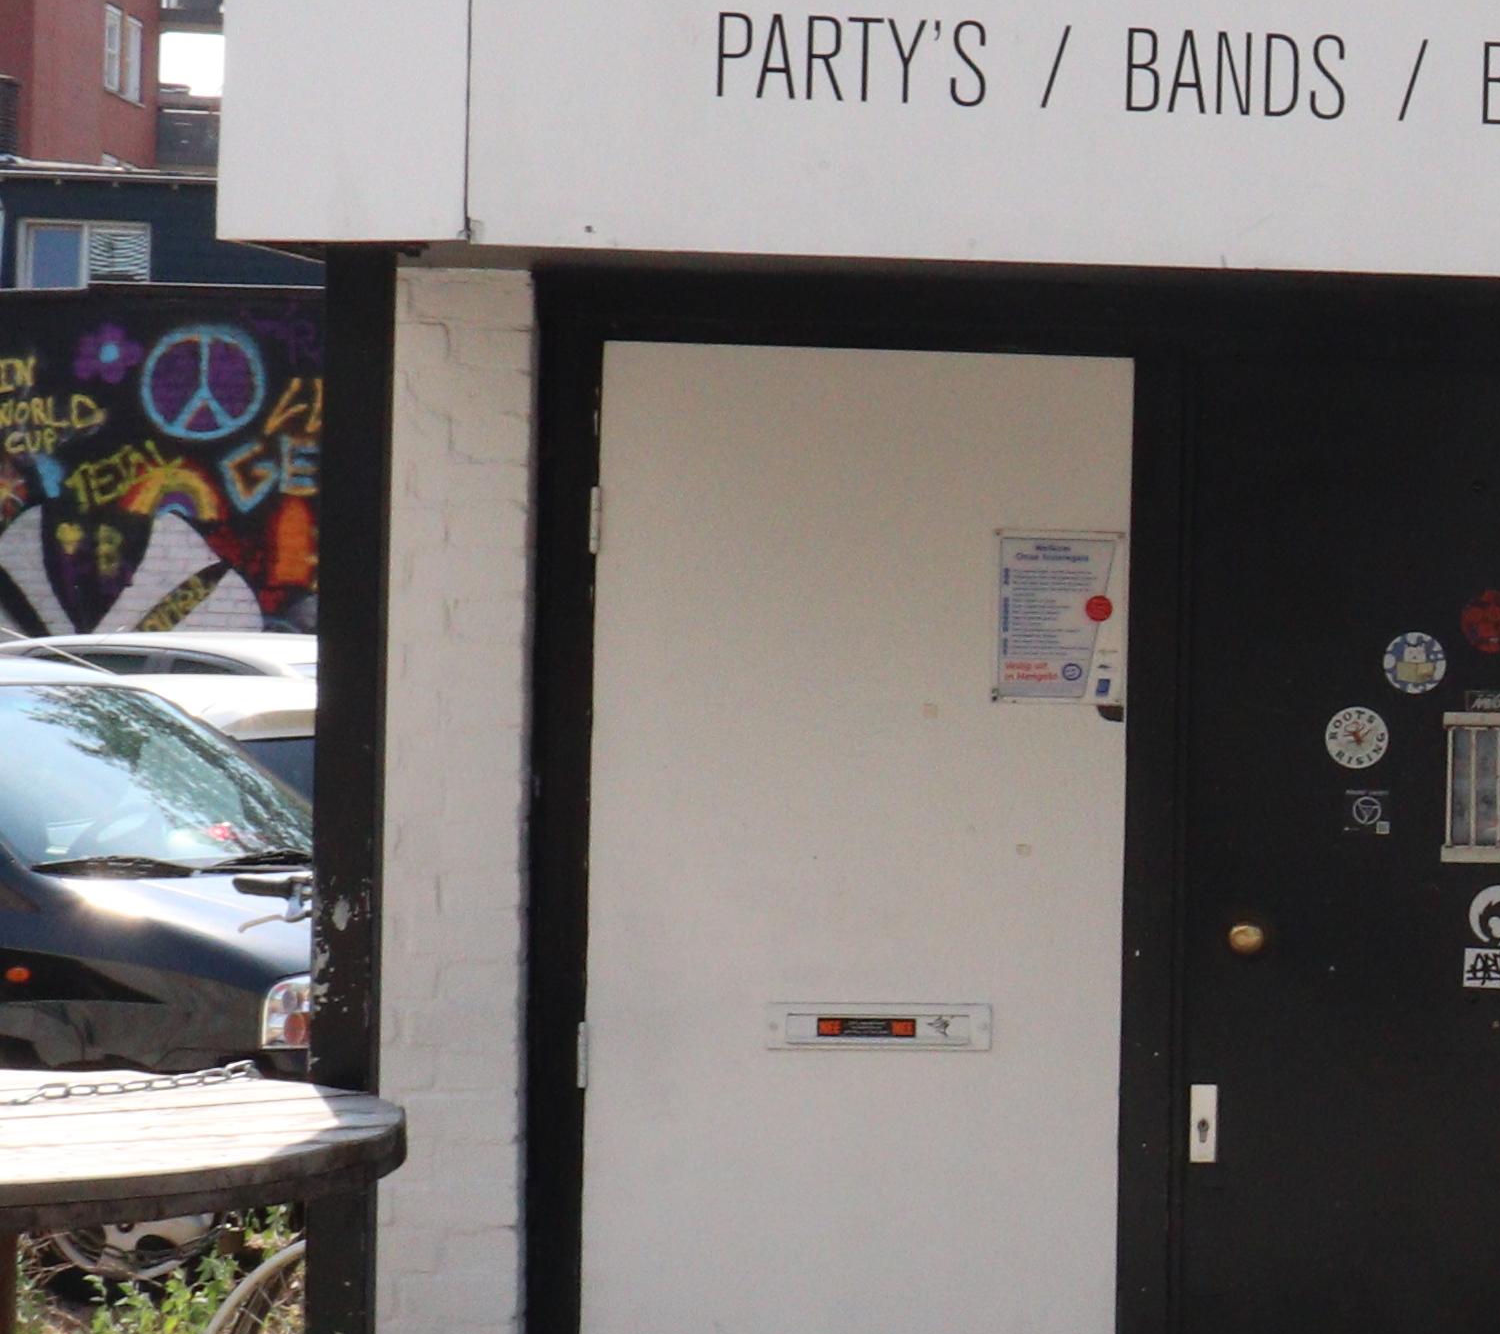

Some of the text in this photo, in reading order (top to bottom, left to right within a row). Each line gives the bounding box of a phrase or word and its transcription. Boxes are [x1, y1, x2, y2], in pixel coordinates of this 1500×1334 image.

[717, 12, 985, 106] PARTY'S
[1041, 26, 1070, 108] /
[1126, 28, 1344, 119] BANDS
[1399, 40, 1427, 120] /
[1335, 733, 1385, 764] RISING
